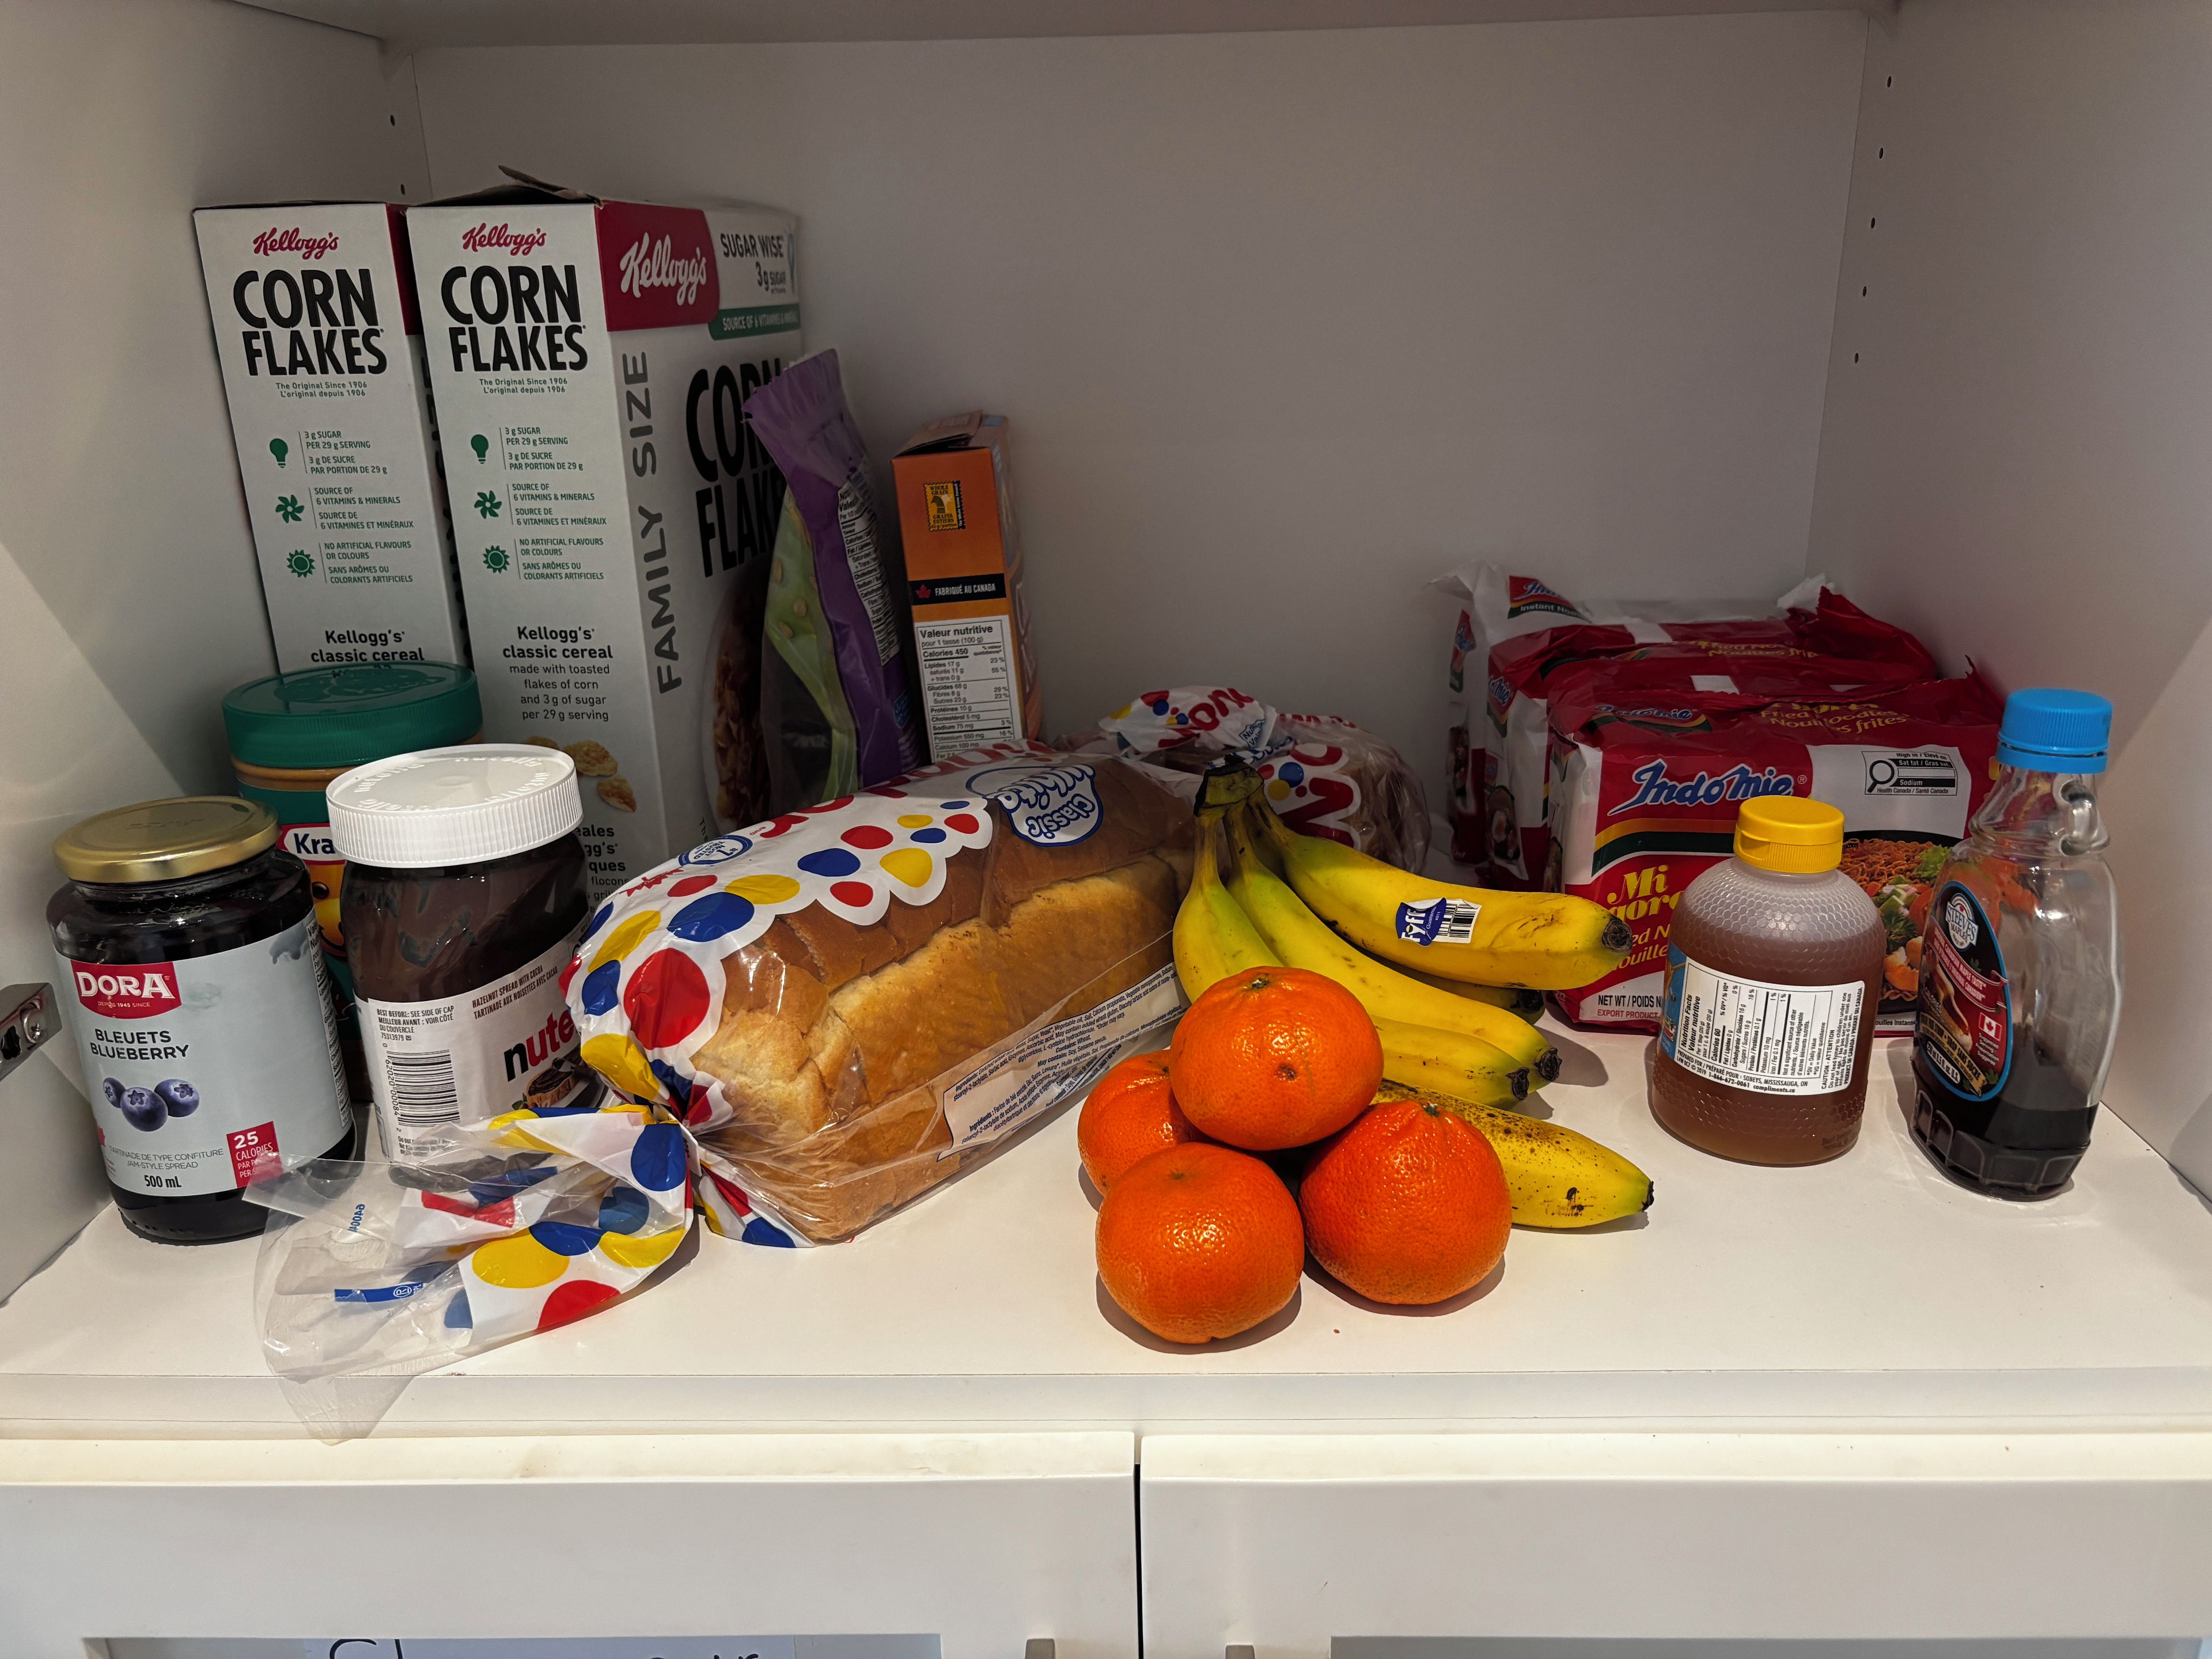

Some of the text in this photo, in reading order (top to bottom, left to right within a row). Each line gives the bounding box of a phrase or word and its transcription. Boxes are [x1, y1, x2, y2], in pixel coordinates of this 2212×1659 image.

[253, 228, 339, 260] Kellogg's
[462, 223, 547, 256] Kellogg's
[721, 234, 784, 258] SUGAR WISE
[620, 232, 707, 306] Kellogg's
[233, 269, 378, 328] CORN
[441, 265, 581, 325] CORN
[242, 328, 387, 376] FLAKES
[449, 325, 588, 372] FLAKES
[292, 382, 323, 391] Original
[319, 390, 344, 398] depuis
[571, 516, 606, 525] MINÉRAUX
[622, 351, 682, 694] FAMILY SIZE
[935, 583, 996, 596] FABRIQUÉ AU CANADA
[1520, 603, 1555, 612] Instant
[325, 630, 405, 646] Kellogg's
[517, 626, 594, 643] Kellogg's
[920, 625, 993, 638] Valeur nutritive
[311, 647, 425, 662] classic cereal
[503, 645, 613, 658] classic cereal
[923, 650, 953, 658] Calories
[510, 664, 609, 674] made with toasted
[525, 679, 599, 689] flakes of corn
[521, 695, 606, 706] and 3 g of sugar
[522, 710, 608, 721] per 29 g serving
[1856, 716, 1906, 733] frites
[1025, 794, 1095, 839] Classic
[293, 833, 335, 854] Kra
[693, 841, 725, 860] TRUSTED
[703, 844, 725, 857] MOST
[1607, 865, 1669, 905] Mi
[1947, 906, 1977, 941] STEEVES
[76, 972, 175, 999] DORA
[472, 965, 543, 1008] HAZELNUT SPREAD WITH COCOA
[474, 966, 558, 1019] TARTINADE AUX NOISETTES AVEC CACAO
[1598, 995, 1654, 1007] NET WT / POIDS
[440, 1013, 454, 1022] CÔTÉ
[1597, 1009, 1658, 1019] EXPORT PRODUCT
[1692, 996, 1700, 1027] nutritive
[95, 1029, 171, 1044] BLEUETS
[1681, 1015, 1690, 1048] Nutrition
[90, 1043, 189, 1060] BLUEBERRY
[503, 1009, 574, 1082] nute
[1055, 1035, 1091, 1053] Contains: Wheat.
[1711, 1029, 1721, 1061] Calories 60
[1825, 1029, 1835, 1060] ATTENTION
[1709, 1071, 1796, 1093] 1-866-672-0061 compliments.ca
[234, 1131, 259, 1149] 25
[109, 1145, 141, 1160] TARTINADE
[175, 1149, 224, 1161] CONFITURE
[236, 1142, 273, 1161] CALORIES
[127, 1161, 198, 1170] JAM-STYLE SPREAD
[238, 1161, 250, 1170] PAR
[240, 1169, 252, 1178] PER
[144, 1175, 181, 1188] 500 mL
